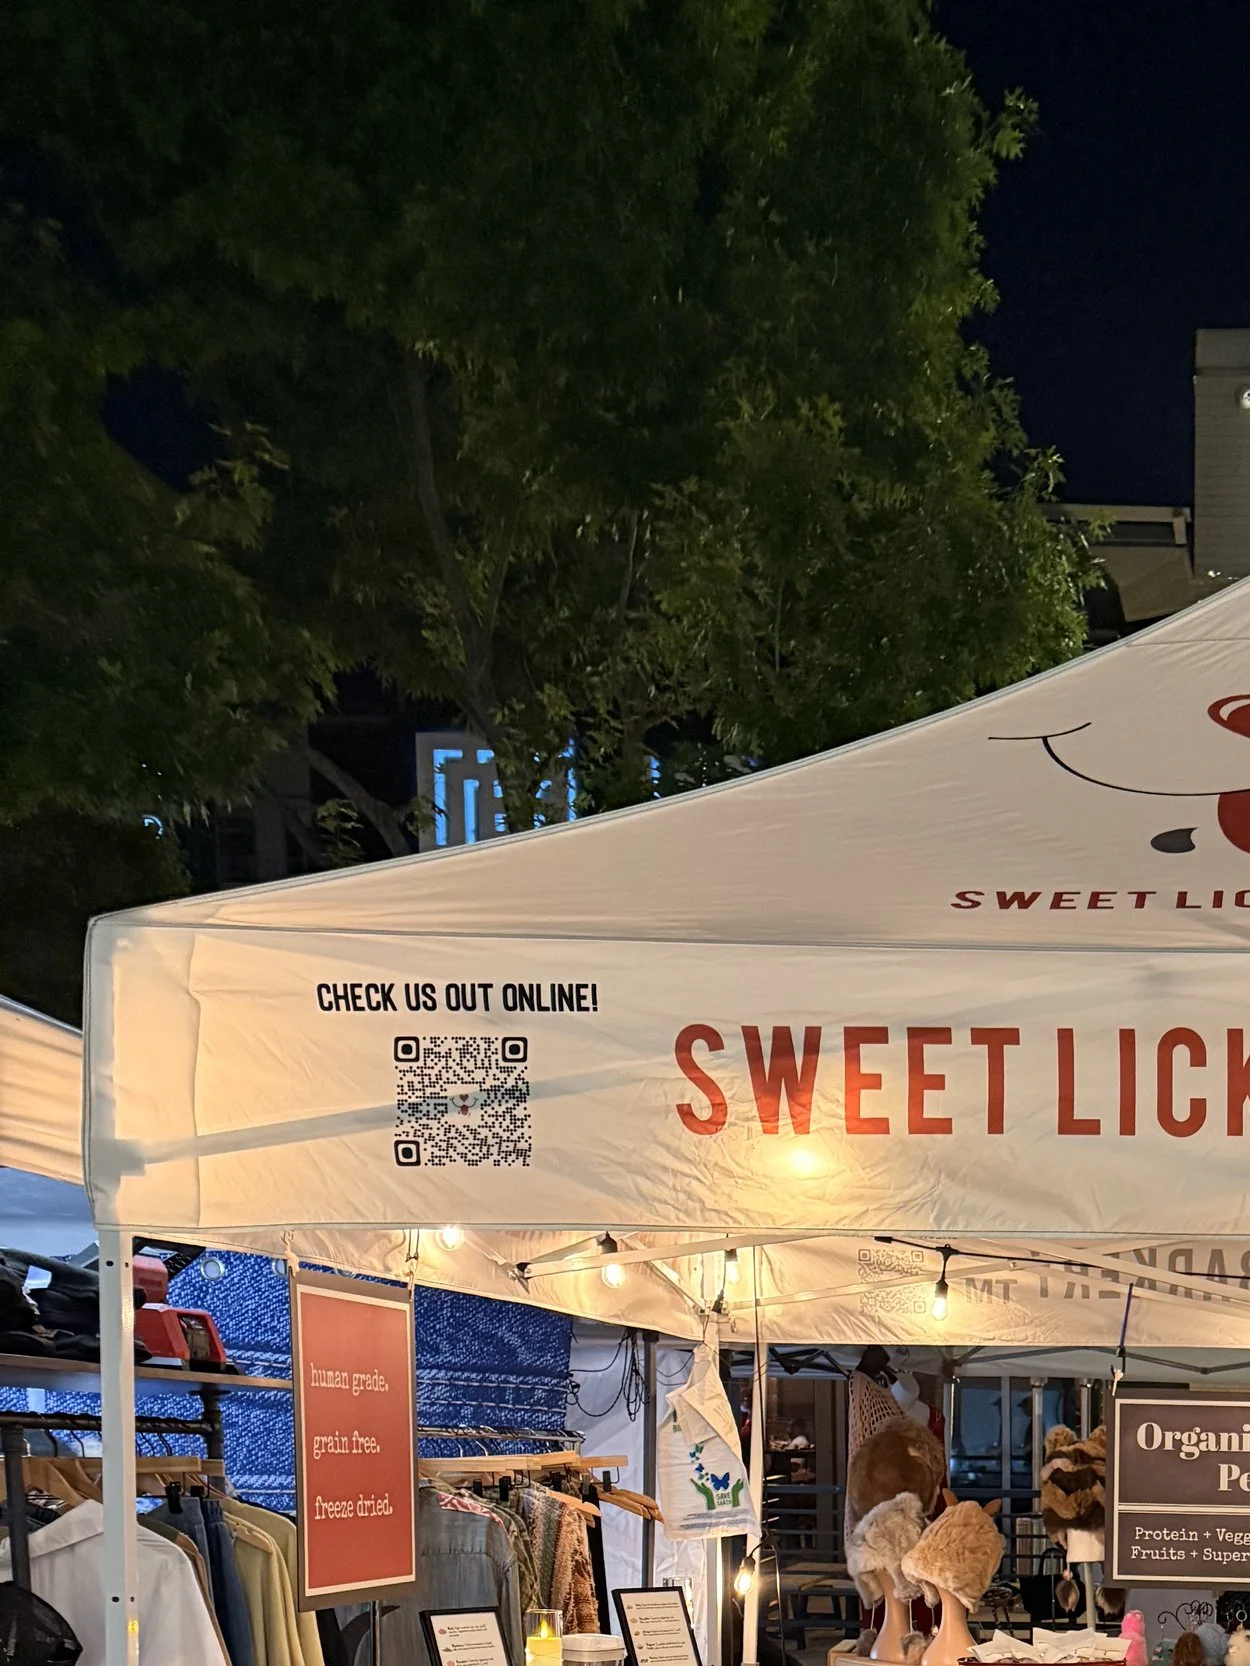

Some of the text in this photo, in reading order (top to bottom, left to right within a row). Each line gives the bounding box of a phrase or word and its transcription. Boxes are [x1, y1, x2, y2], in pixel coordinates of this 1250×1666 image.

[951, 889, 1156, 910] SWEET
[316, 983, 599, 1012] CHECK US OUT ONLINE!
[675, 1023, 1020, 1137] SWEET
[310, 1363, 389, 1396] human grade.
[313, 1430, 380, 1459] grain free.
[314, 1493, 393, 1520] freeze dried.
[1134, 1526, 1199, 1542] Protein
[1130, 1546, 1186, 1561] Fruits
